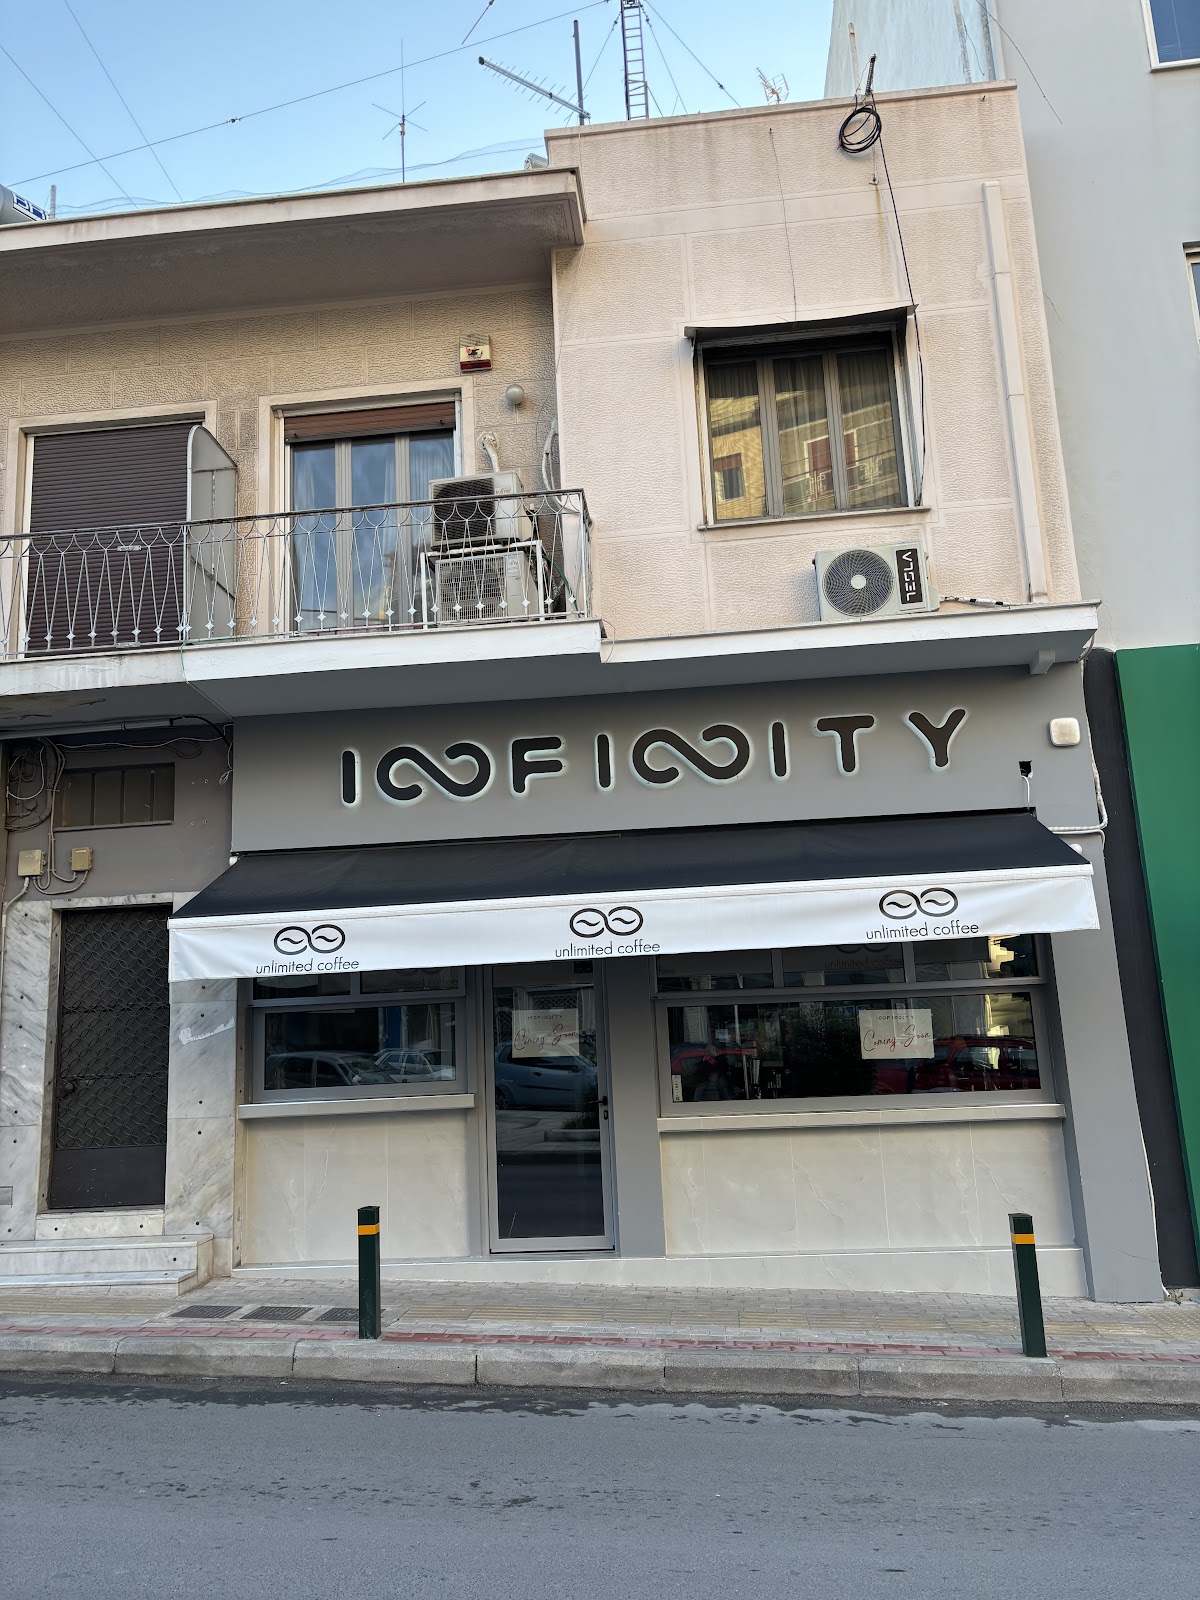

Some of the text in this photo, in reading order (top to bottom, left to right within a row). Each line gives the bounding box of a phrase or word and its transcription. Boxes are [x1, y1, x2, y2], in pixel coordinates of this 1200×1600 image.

[901, 551, 916, 602] TESLA
[866, 919, 980, 940] unlimited coffee
[555, 939, 660, 957] unlimited coffee
[256, 956, 360, 974] unlimited coffee
[863, 1024, 931, 1052] Coming Soon
